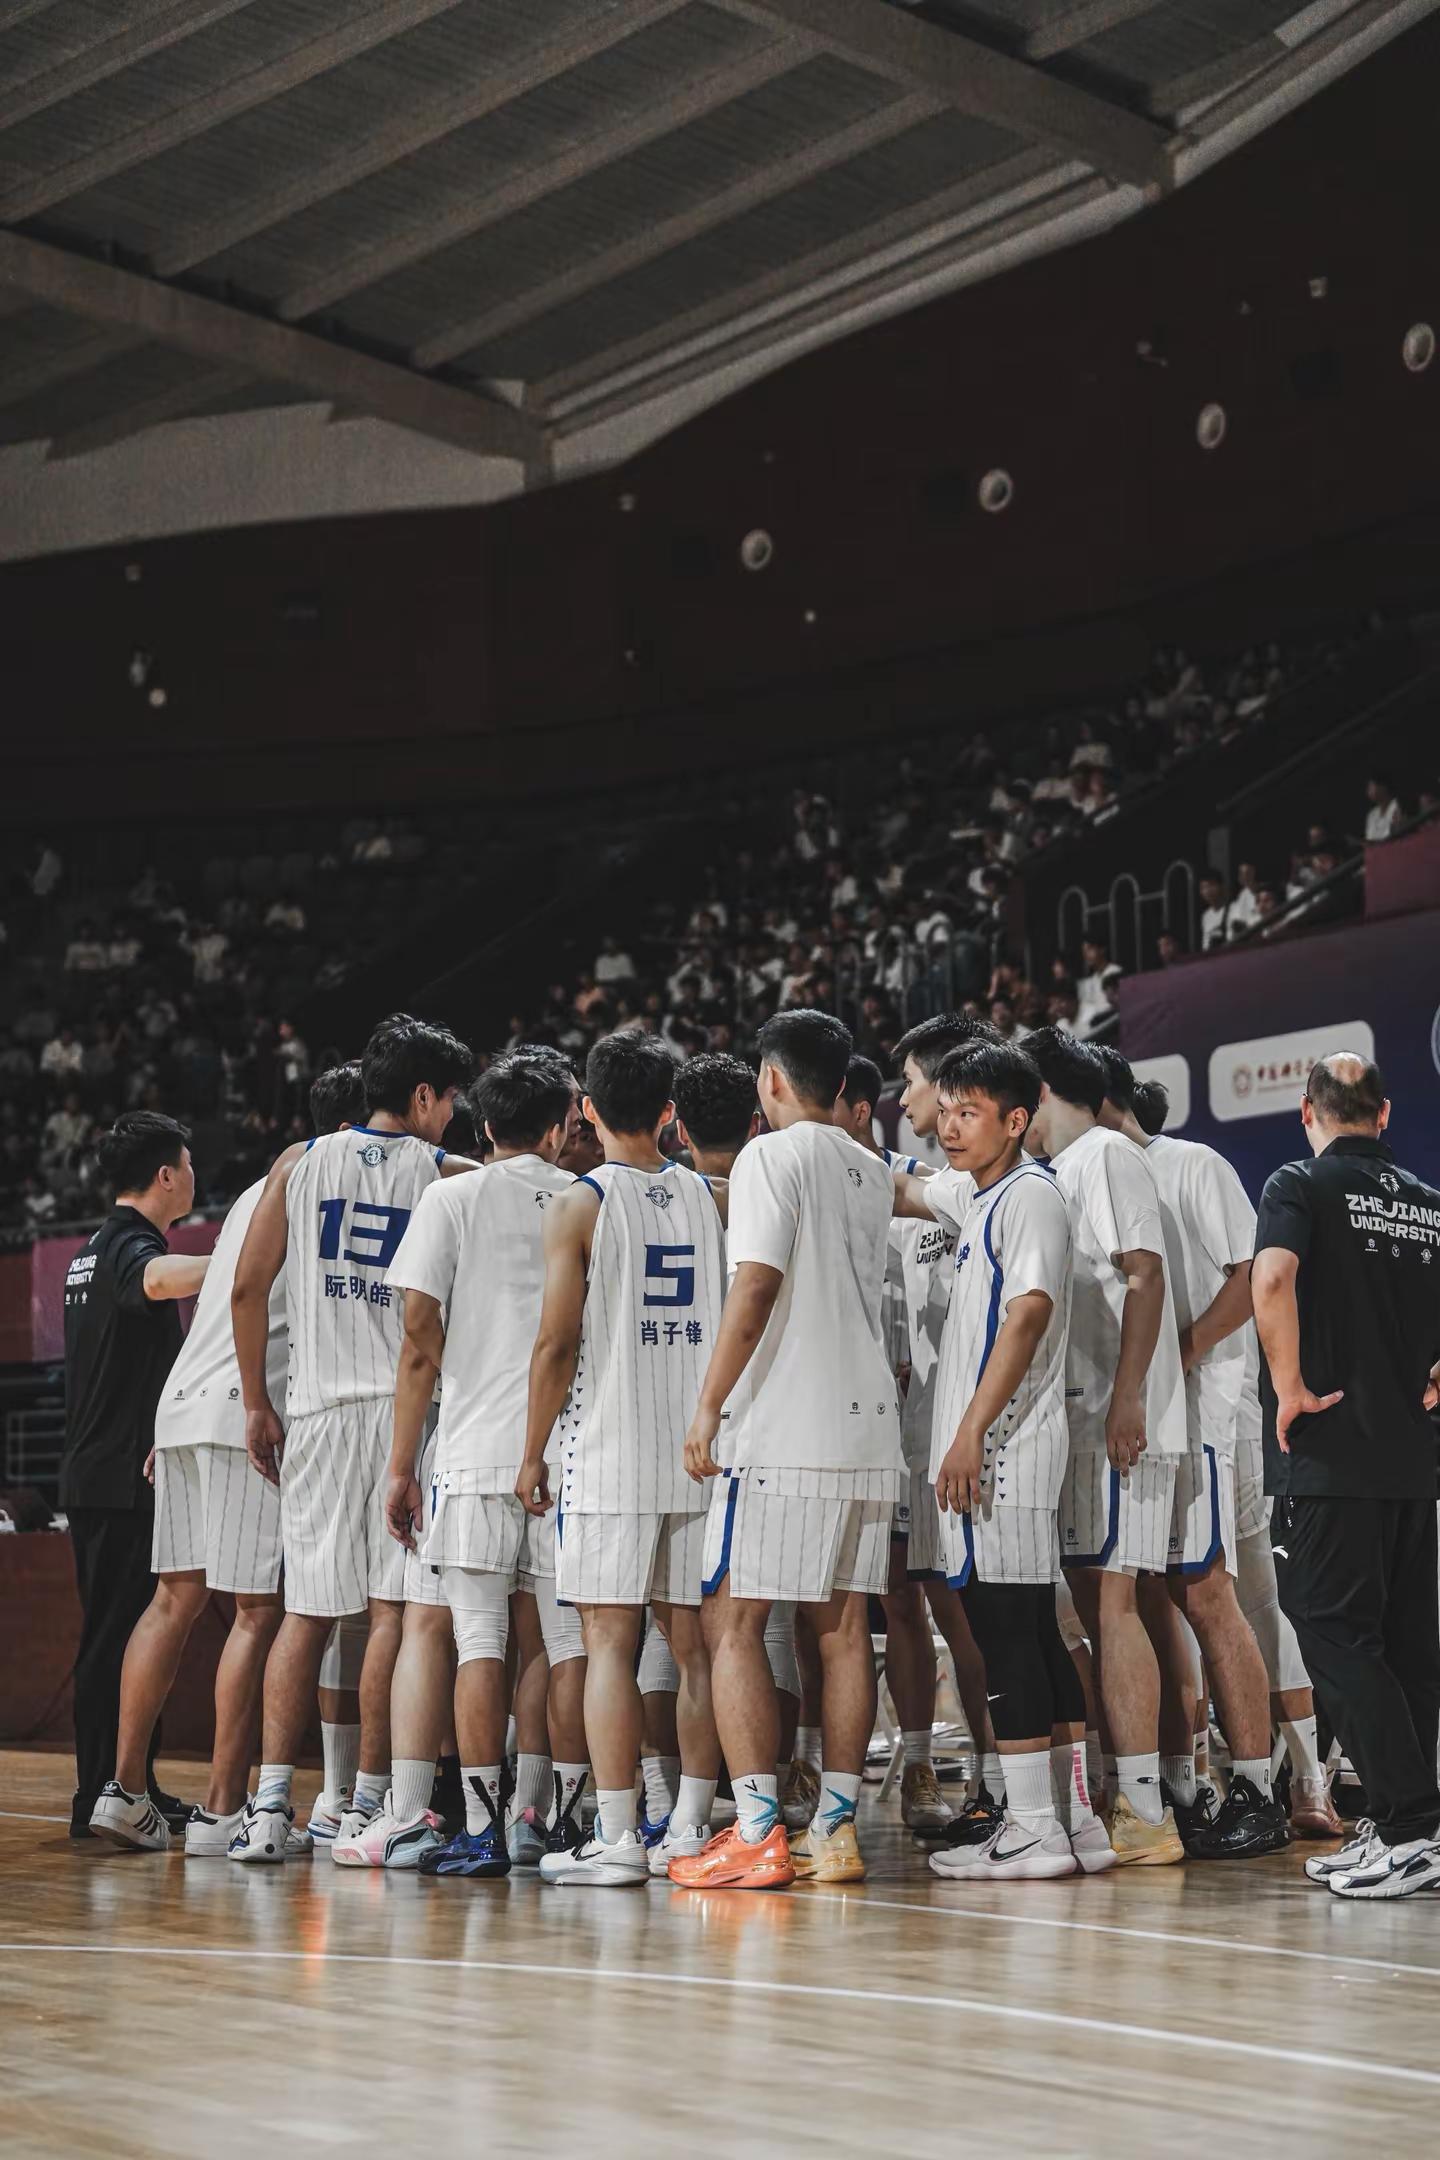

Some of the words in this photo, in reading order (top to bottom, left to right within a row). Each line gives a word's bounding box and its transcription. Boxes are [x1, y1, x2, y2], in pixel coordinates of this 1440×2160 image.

[1345, 1194, 1440, 1228] ZHEJIANG
[318, 1199, 411, 1268] 13
[1350, 1214, 1440, 1247] UNIVERSITY
[325, 1274, 392, 1308] 阮明皓
[643, 1244, 695, 1306] 5
[640, 1320, 703, 1346] 肖子锋
